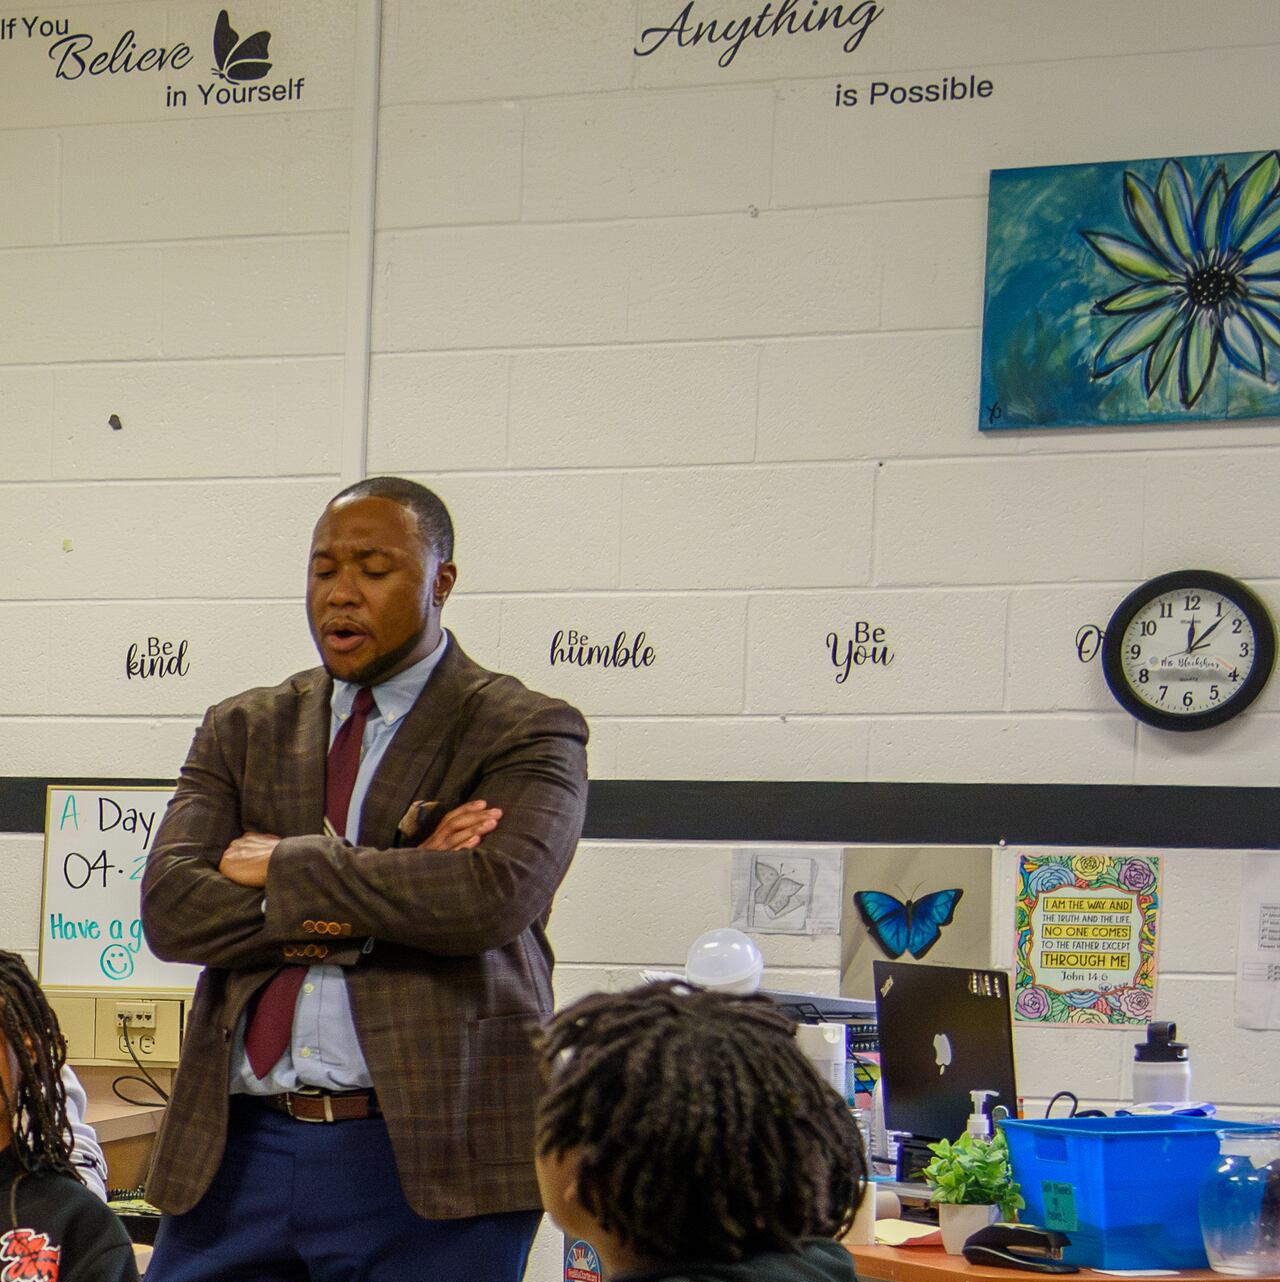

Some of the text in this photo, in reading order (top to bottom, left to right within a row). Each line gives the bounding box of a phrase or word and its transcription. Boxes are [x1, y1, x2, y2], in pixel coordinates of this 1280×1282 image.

[0, 16, 70, 40] If You
[633, 0, 886, 68] Anything
[48, 29, 195, 81] Believe
[166, 77, 306, 108] in Yourself
[835, 74, 995, 108] is Possible
[1158, 601, 1174, 619] 11
[1183, 594, 1201, 611] 12
[1214, 601, 1223, 617] 1
[854, 620, 887, 644] Be
[1140, 619, 1158, 637] 10
[1231, 618, 1243, 634] 2
[147, 636, 174, 657] Be
[567, 629, 590, 647] Be
[549, 629, 657, 669] humble
[1130, 643, 1141, 660] 9
[1238, 641, 1250, 658] 3
[125, 639, 191, 680] kind
[825, 631, 895, 685] You
[1138, 667, 1150, 684] 8
[1227, 666, 1240, 683] 4
[1158, 685, 1169, 701] 7
[1182, 690, 1194, 707] 6
[1209, 684, 1220, 701] 5
[59, 794, 156, 850] A Day
[1054, 900, 1130, 911] AM THE WAY AND
[49, 912, 102, 940] Have
[109, 919, 124, 940] a
[1042, 914, 1056, 923] THE
[1057, 914, 1080, 924] TRUTH
[1081, 914, 1099, 924] AND
[1099, 914, 1114, 924] THE
[1044, 926, 1129, 938] NO ONE COMES
[1041, 940, 1131, 951] TO THE FATHER EXCEPT
[1044, 953, 1128, 968] THROUGH ME
[1060, 970, 1085, 982] John
